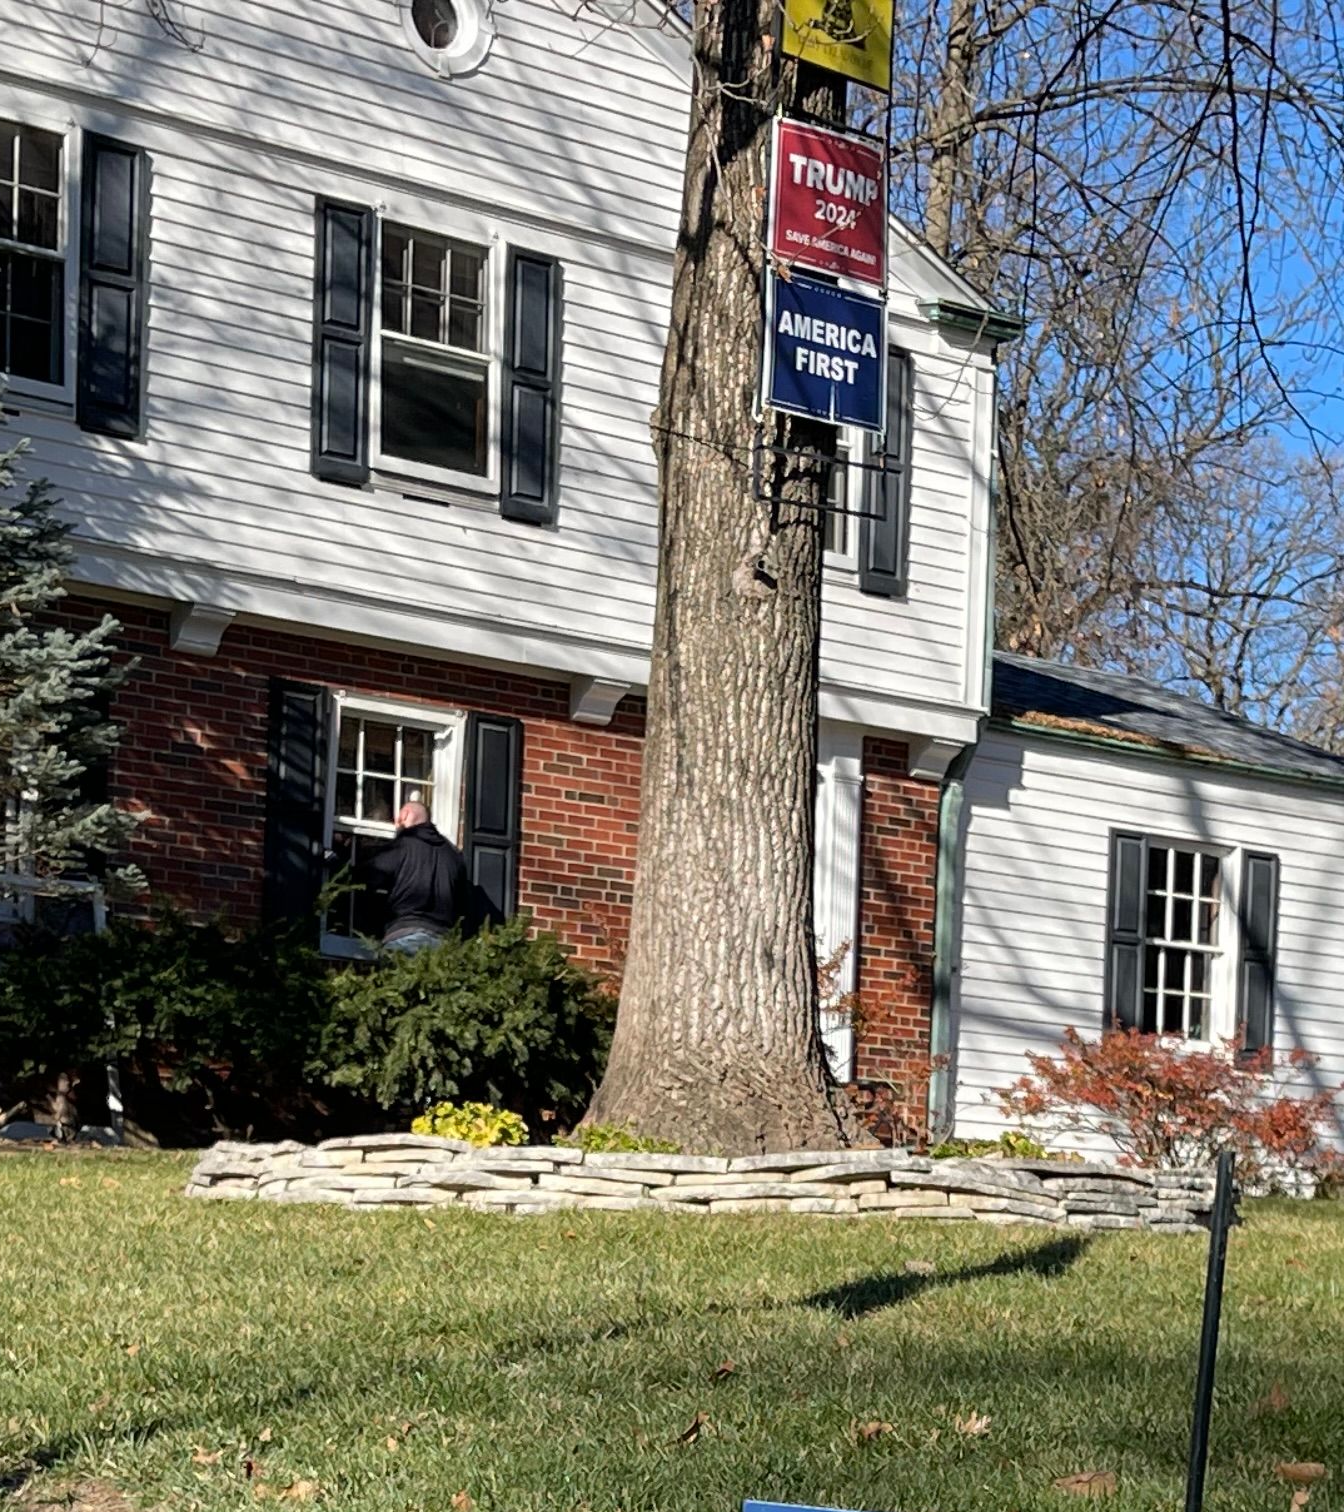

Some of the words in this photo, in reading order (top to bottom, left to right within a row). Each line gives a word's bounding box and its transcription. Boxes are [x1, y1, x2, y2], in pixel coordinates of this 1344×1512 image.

[789, 153, 878, 206] TRUMP
[814, 200, 857, 230] 2024
[785, 229, 810, 246] SAVE
[778, 310, 877, 359] AMERICA
[795, 346, 859, 385] FIRST
